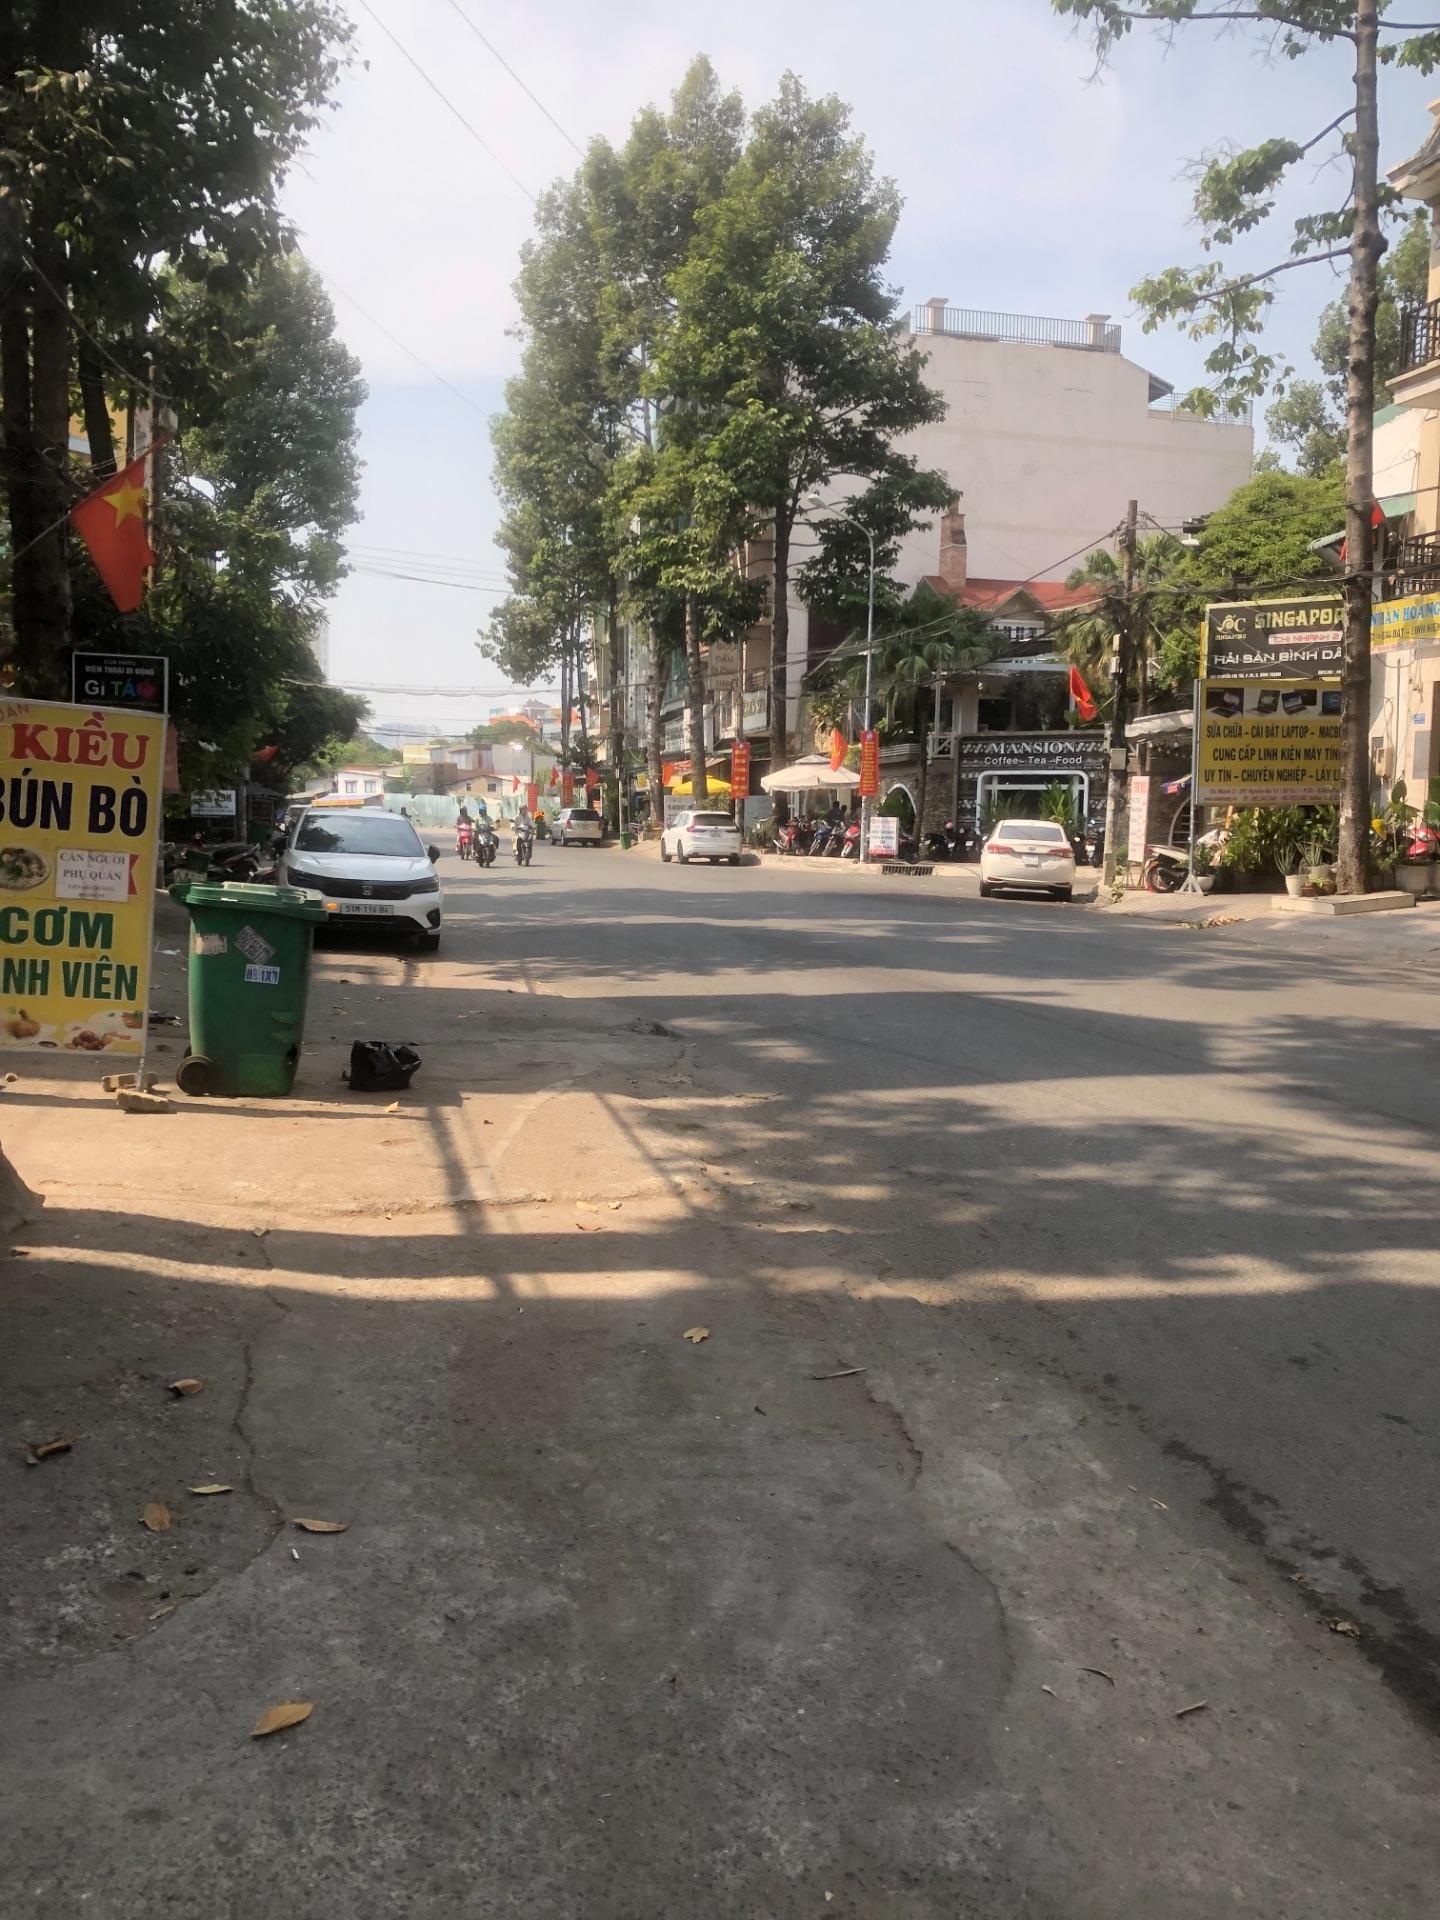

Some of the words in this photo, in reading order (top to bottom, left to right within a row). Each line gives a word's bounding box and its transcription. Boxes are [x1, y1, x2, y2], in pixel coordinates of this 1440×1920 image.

[1278, 648, 1318, 662] BÌNH
[1282, 726, 1309, 739] LAPTOP
[10, 711, 150, 769] KIỀU
[989, 742, 1076, 754] MANSION
[1213, 748, 1236, 761] CUNG
[1259, 748, 1278, 761] LINH
[984, 757, 1018, 765] Coffee
[1028, 756, 1047, 765] Tea
[1056, 756, 1083, 765] Food
[1204, 769, 1216, 782] UY
[0, 768, 73, 831] ÚN
[88, 775, 148, 837] BÒ
[0, 906, 114, 949] CƠM
[62, 955, 138, 1001] VIÊN
